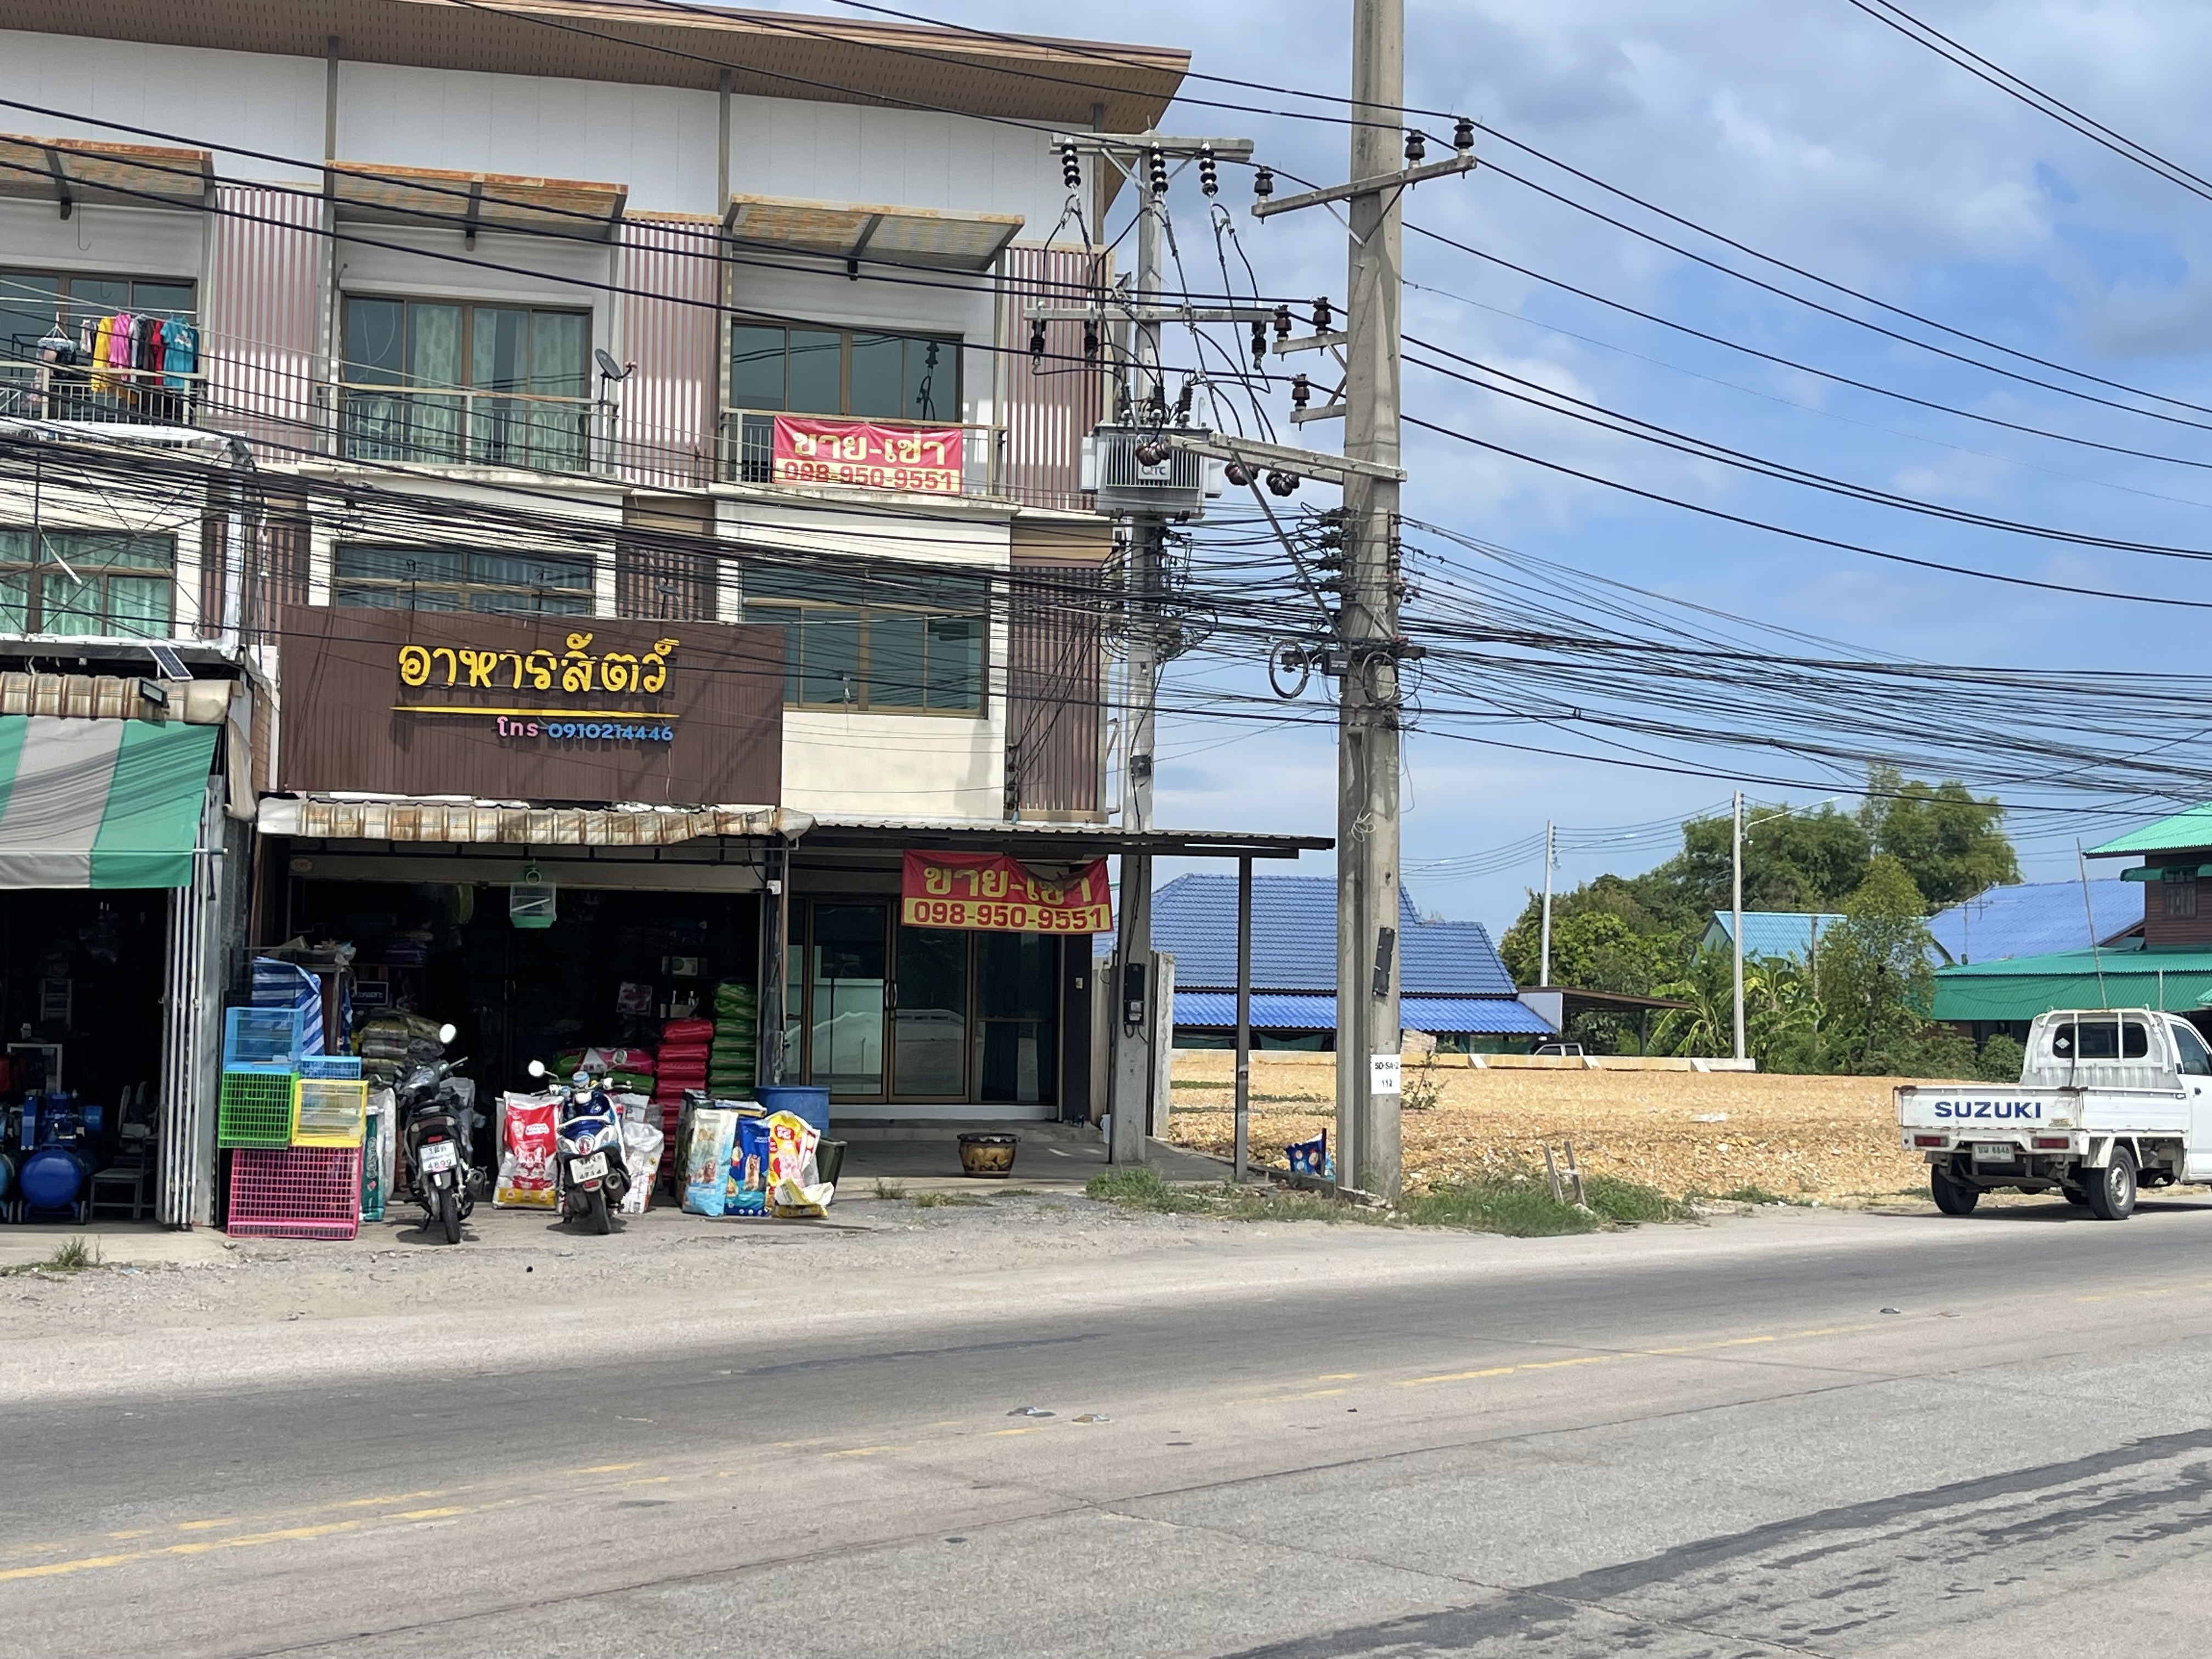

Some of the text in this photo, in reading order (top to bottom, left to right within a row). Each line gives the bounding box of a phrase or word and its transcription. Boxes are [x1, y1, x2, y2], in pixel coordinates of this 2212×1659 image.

[792, 430, 945, 465] ขาย-เช่า
[785, 461, 952, 489] 098-950-9551
[1142, 465, 1166, 476] QTC
[399, 633, 680, 693] อาหารสัตว์
[497, 716, 674, 741] โทร 0910214446
[914, 901, 1102, 929] 098-950-9551
[1934, 1102, 2041, 1118] SUZUKI
